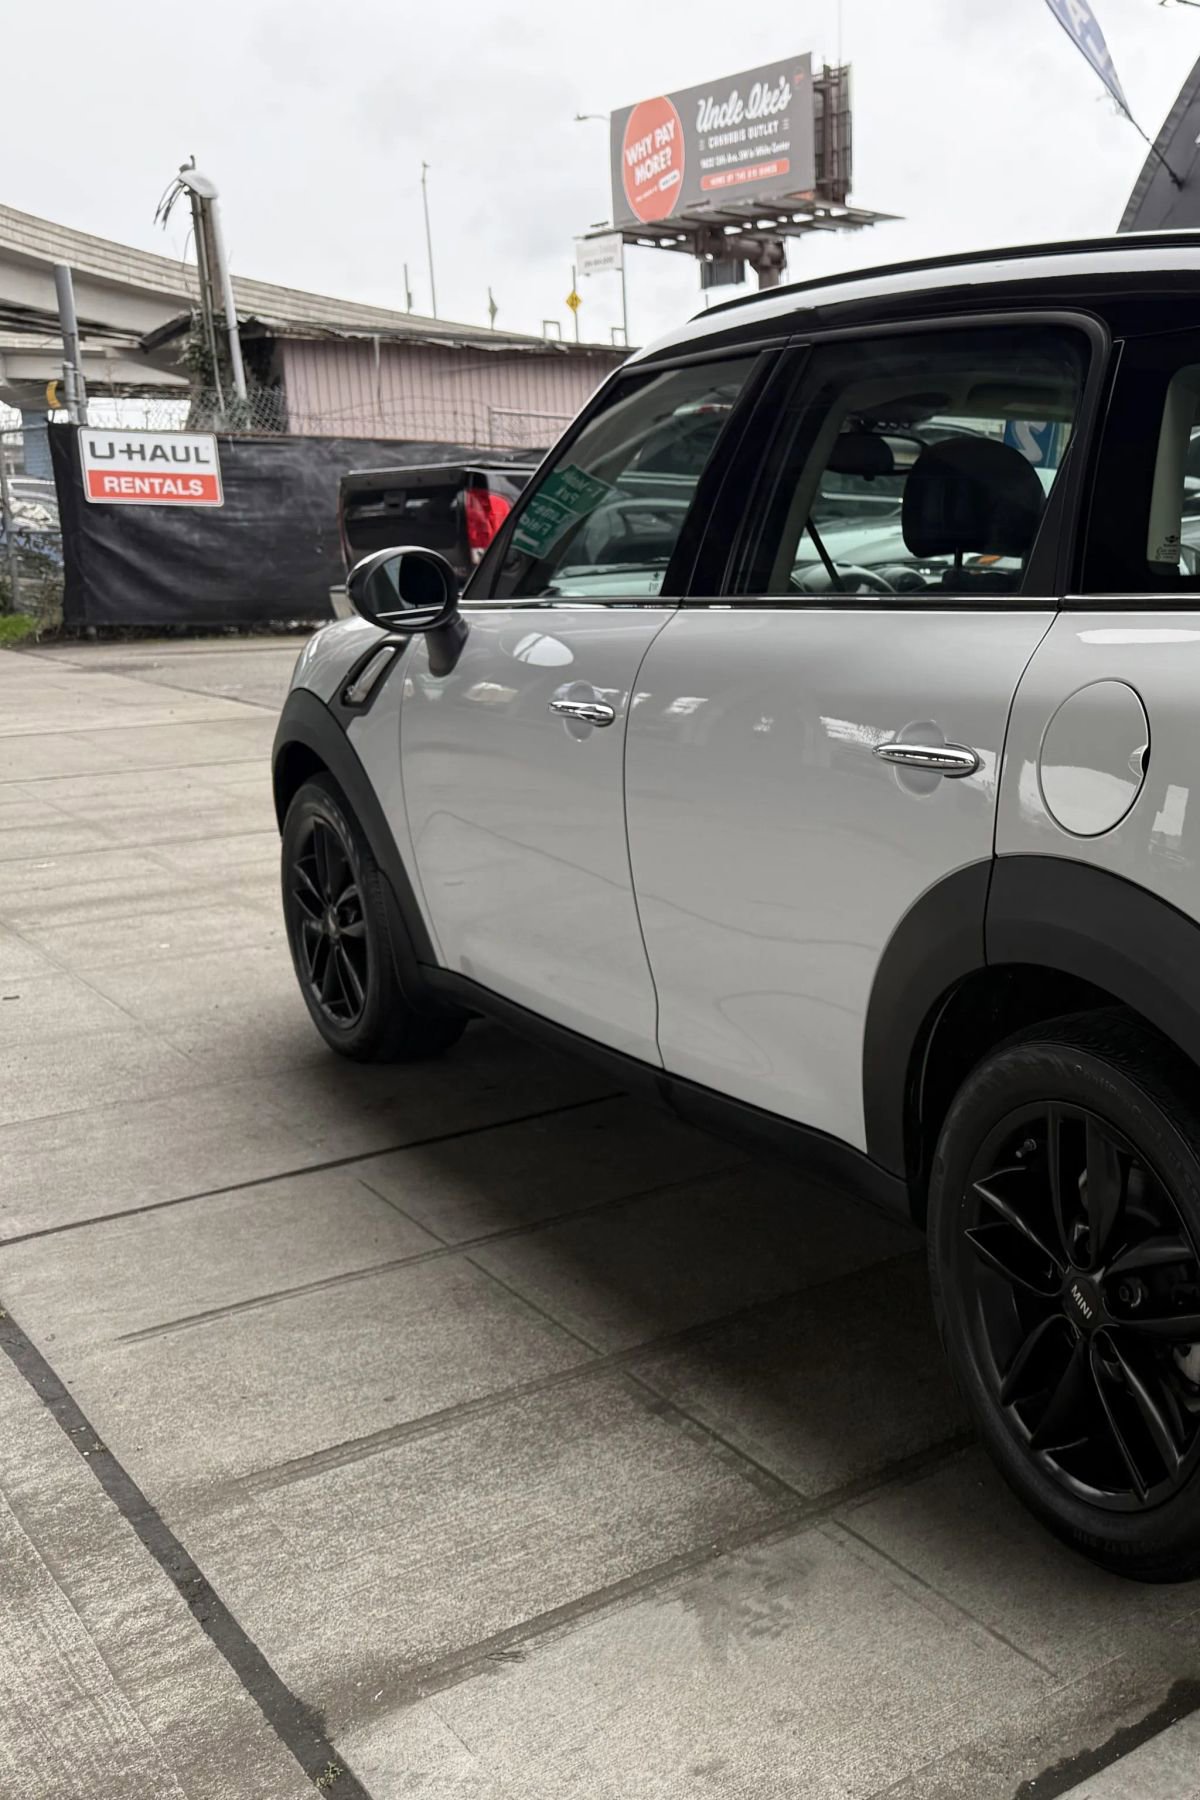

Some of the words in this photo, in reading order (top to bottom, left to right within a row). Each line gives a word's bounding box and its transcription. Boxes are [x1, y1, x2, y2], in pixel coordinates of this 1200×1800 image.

[696, 90, 744, 133] Uncle
[745, 76, 792, 119] Ike's
[626, 133, 652, 167] WHY
[654, 118, 676, 149] PAY
[748, 120, 779, 140] OUTLET
[634, 146, 672, 186] MORE?
[88, 441, 211, 464] U-HAUL
[103, 475, 204, 497] RENTALS
[1071, 1284, 1093, 1320] MINI
